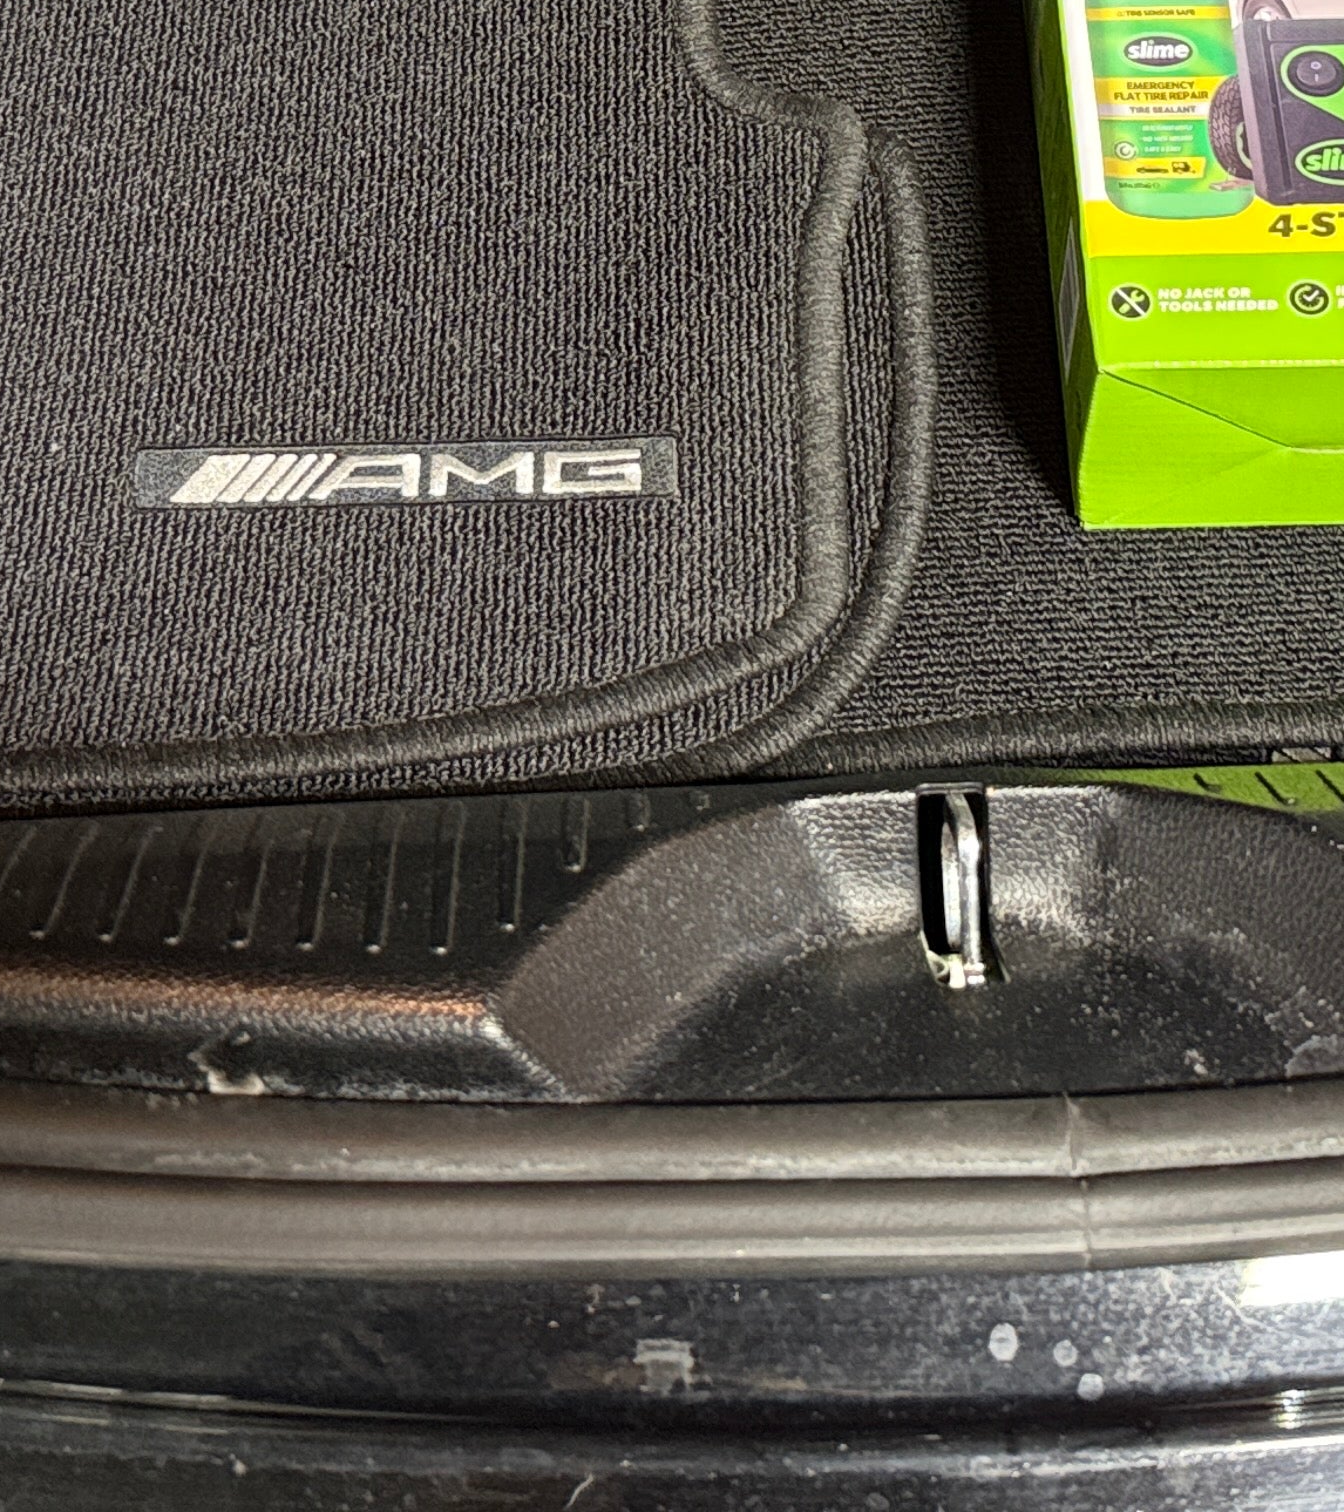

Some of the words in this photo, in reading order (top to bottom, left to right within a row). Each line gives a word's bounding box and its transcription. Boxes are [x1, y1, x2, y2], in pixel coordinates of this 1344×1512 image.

[1127, 39, 1190, 60] slime
[1126, 80, 1195, 90] EMERGENCY
[1113, 91, 1141, 101] FLAT
[1143, 91, 1168, 101] TIRE
[1168, 90, 1209, 100] REPAIR
[1129, 106, 1150, 114] TIRE
[1152, 105, 1197, 114] SEALANT
[1157, 287, 1182, 299] NO
[1184, 287, 1225, 299] JACK
[1227, 286, 1251, 298] OR
[1159, 300, 1213, 312] TOOLS
[1215, 299, 1279, 311] NEEDED
[307, 448, 643, 500] AMG
